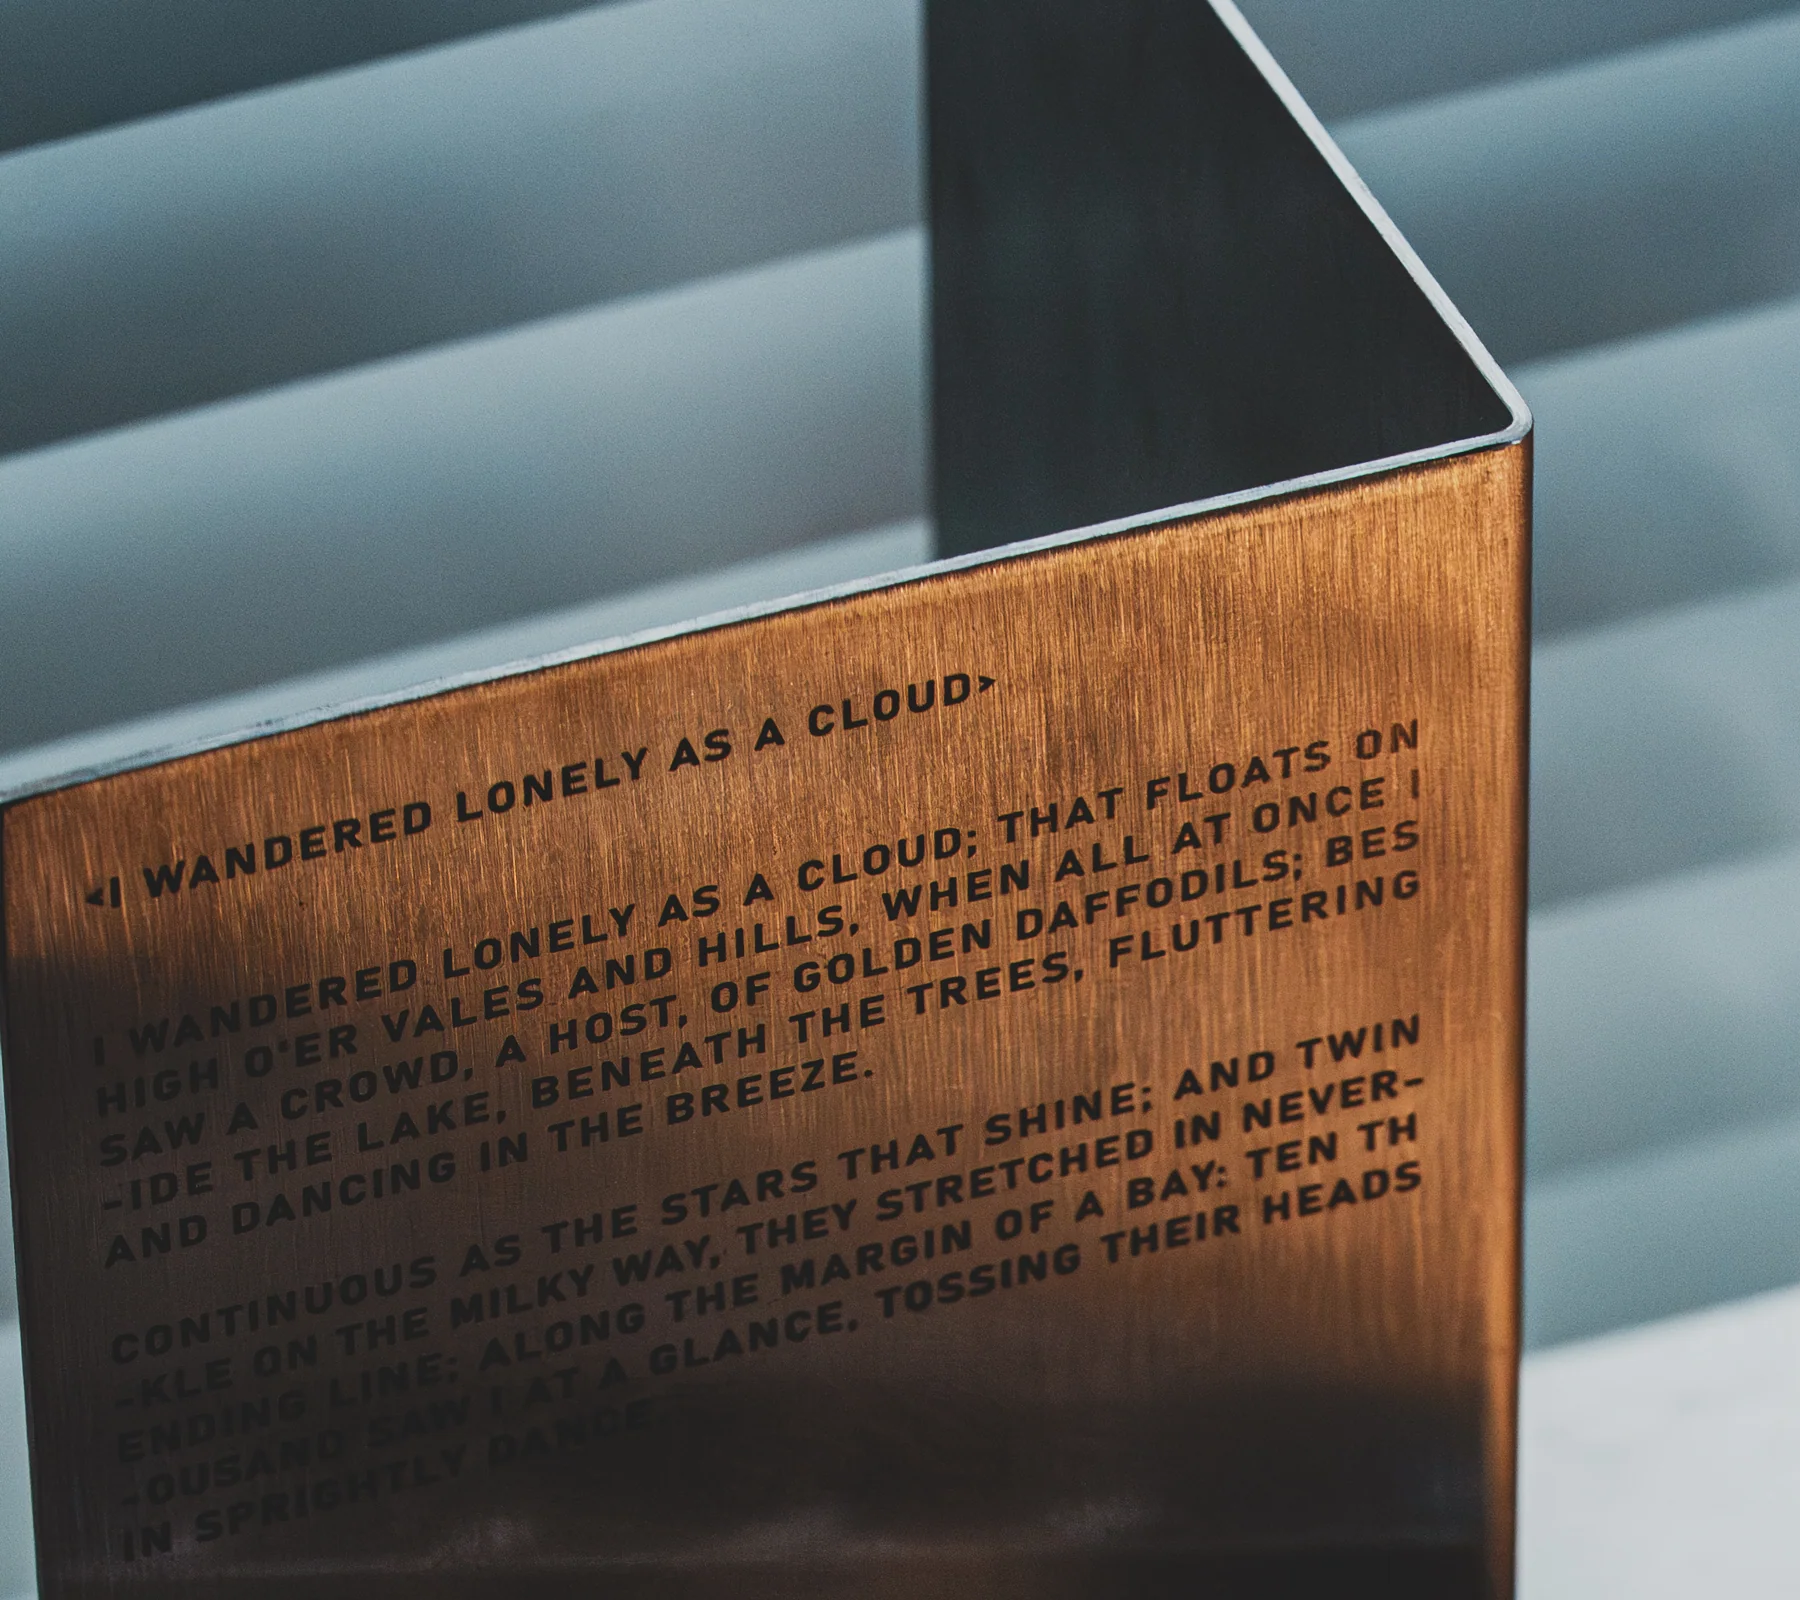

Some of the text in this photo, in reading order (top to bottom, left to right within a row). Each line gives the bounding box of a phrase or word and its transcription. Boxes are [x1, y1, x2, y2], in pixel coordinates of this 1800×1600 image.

[93, 718, 1421, 1067] I WANDERED LONELY AS A CLOUD; THAT FLOATS ON
[96, 1056, 219, 1117] HIGH
[380, 977, 544, 1045] VALES
[566, 945, 673, 997] AND
[699, 903, 861, 967] HILLS,
[881, 860, 1032, 922] WHEN
[1054, 836, 1149, 883] ALL
[1170, 812, 1232, 856] AT
[1251, 777, 1387, 835] ONCE
[1410, 768, 1421, 801] I
[143, 801, 432, 897] WANDERED
[455, 748, 647, 824] LONELY
[669, 728, 732, 770] AS
[753, 718, 785, 749] A
[99, 819, 1421, 1168] SAW A CROWD, A HOST, OF GOLDEN DAFFODILS; BES
[233, 1130, 333, 1182] THE
[357, 1090, 507, 1153] LAKE,
[531, 1023, 768, 1110] BENEATH
[788, 994, 886, 1045] THE
[905, 949, 1085, 1015] TREES,
[1108, 869, 1421, 968] FLUTTERING
[103, 1051, 874, 1270] AND DANCING IN THE BREEZE.
[110, 1255, 438, 1366] CONTINUOUS
[459, 1233, 521, 1278] AS
[541, 1204, 639, 1254] THE
[659, 1158, 819, 1226] STARS
[837, 1123, 965, 1182] THAT
[1173, 1051, 1275, 1099] AND
[1297, 1013, 1421, 1070] TWIN
[116, 1390, 308, 1464] ENDING
[479, 1303, 647, 1372] ALONG
[663, 1274, 758, 1324] THE
[779, 1219, 974, 1297] MARGIN
[992, 1200, 1054, 1241] OF
[1074, 1189, 1105, 1223] A
[1245, 1131, 1338, 1181] TEN
[1357, 1111, 1419, 1154] TH
[252, 1334, 318, 1378] ON
[336, 1306, 430, 1356] THE
[450, 1263, 595, 1330] MILKY
[612, 1239, 720, 1286] WAY,
[736, 1203, 857, 1257] THEY
[876, 1131, 1153, 1222] STRETCHED
[1174, 1112, 1221, 1150] IN
[1240, 1065, 1425, 1133] NEVER-
[367, 1394, 472, 1449] SAW
[524, 1366, 581, 1409] AT
[598, 1356, 629, 1391] A
[875, 1242, 1082, 1319] TOSSING
[1100, 1203, 1241, 1264] THEIR
[1261, 1160, 1422, 1228] HEADS
